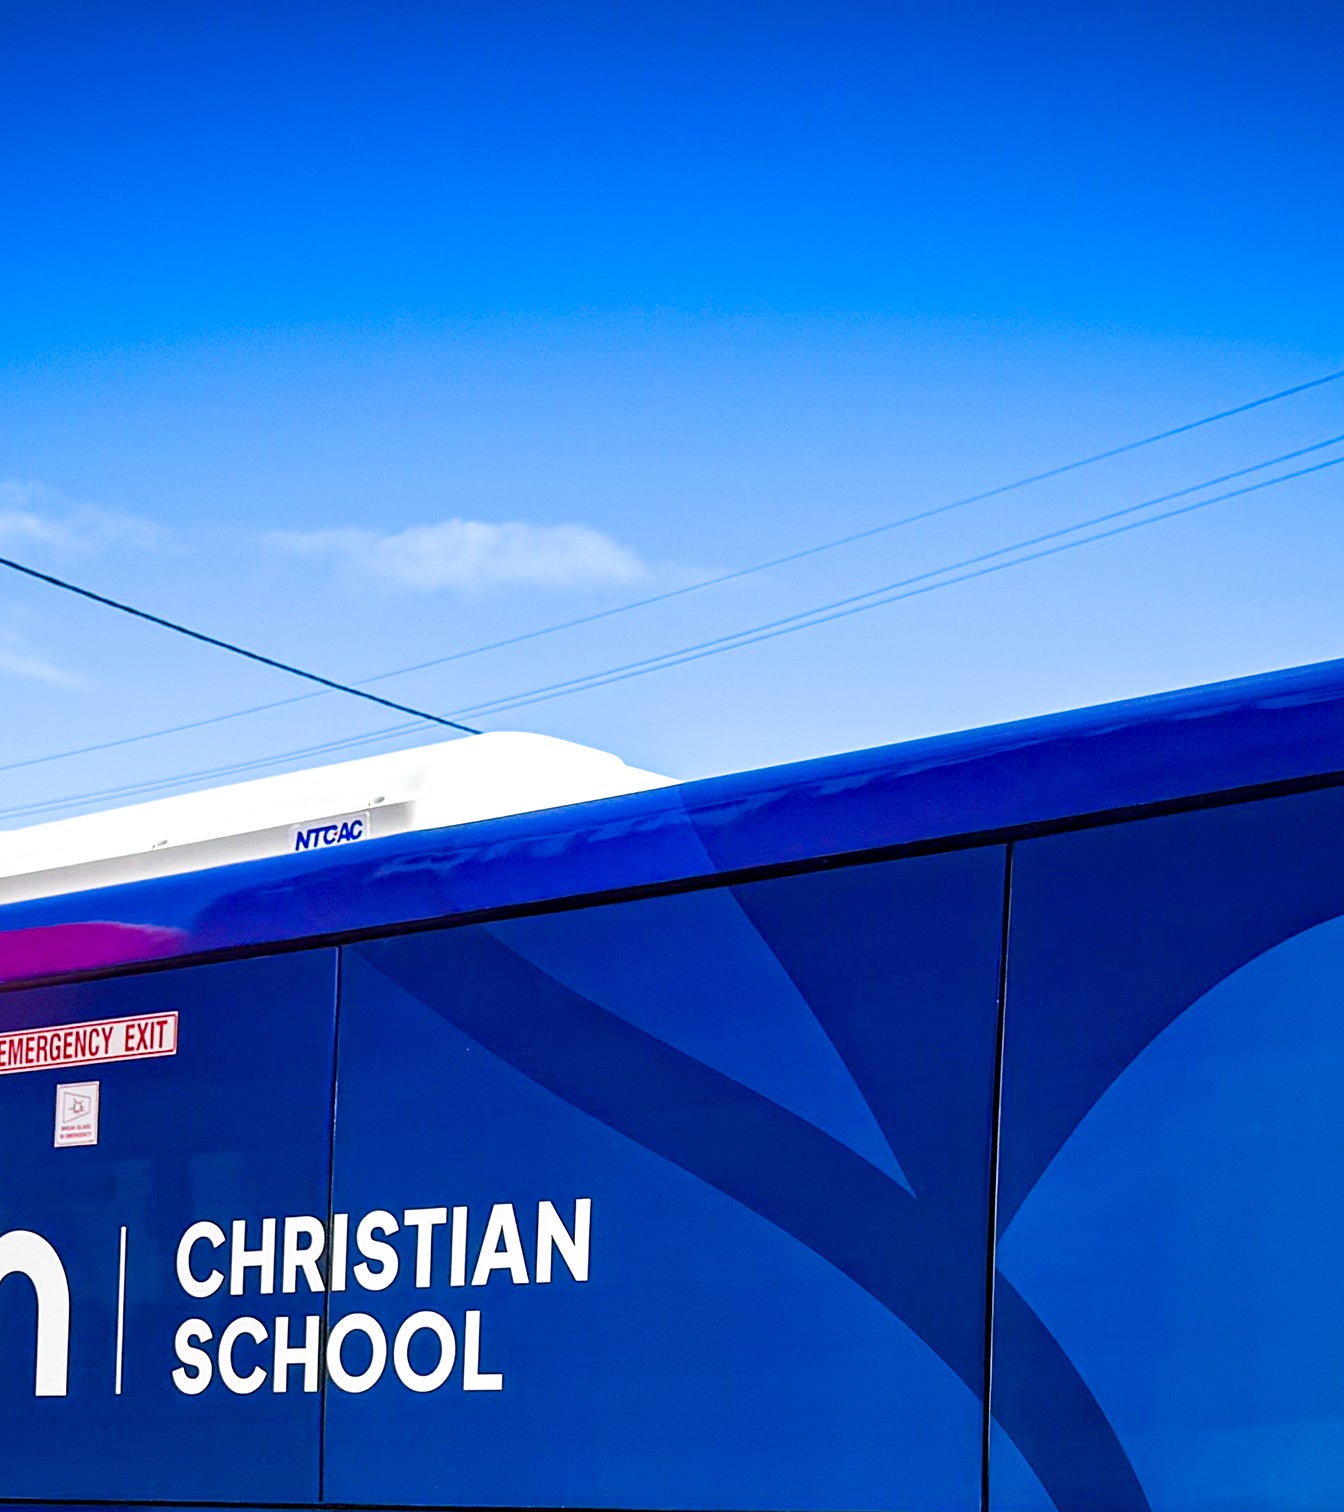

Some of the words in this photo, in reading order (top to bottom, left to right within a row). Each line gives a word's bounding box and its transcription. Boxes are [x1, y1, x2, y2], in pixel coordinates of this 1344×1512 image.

[124, 1020, 168, 1052] EXIT
[176, 1198, 592, 1298] CHRISTIAN
[172, 1310, 503, 1395] SCHOOL
